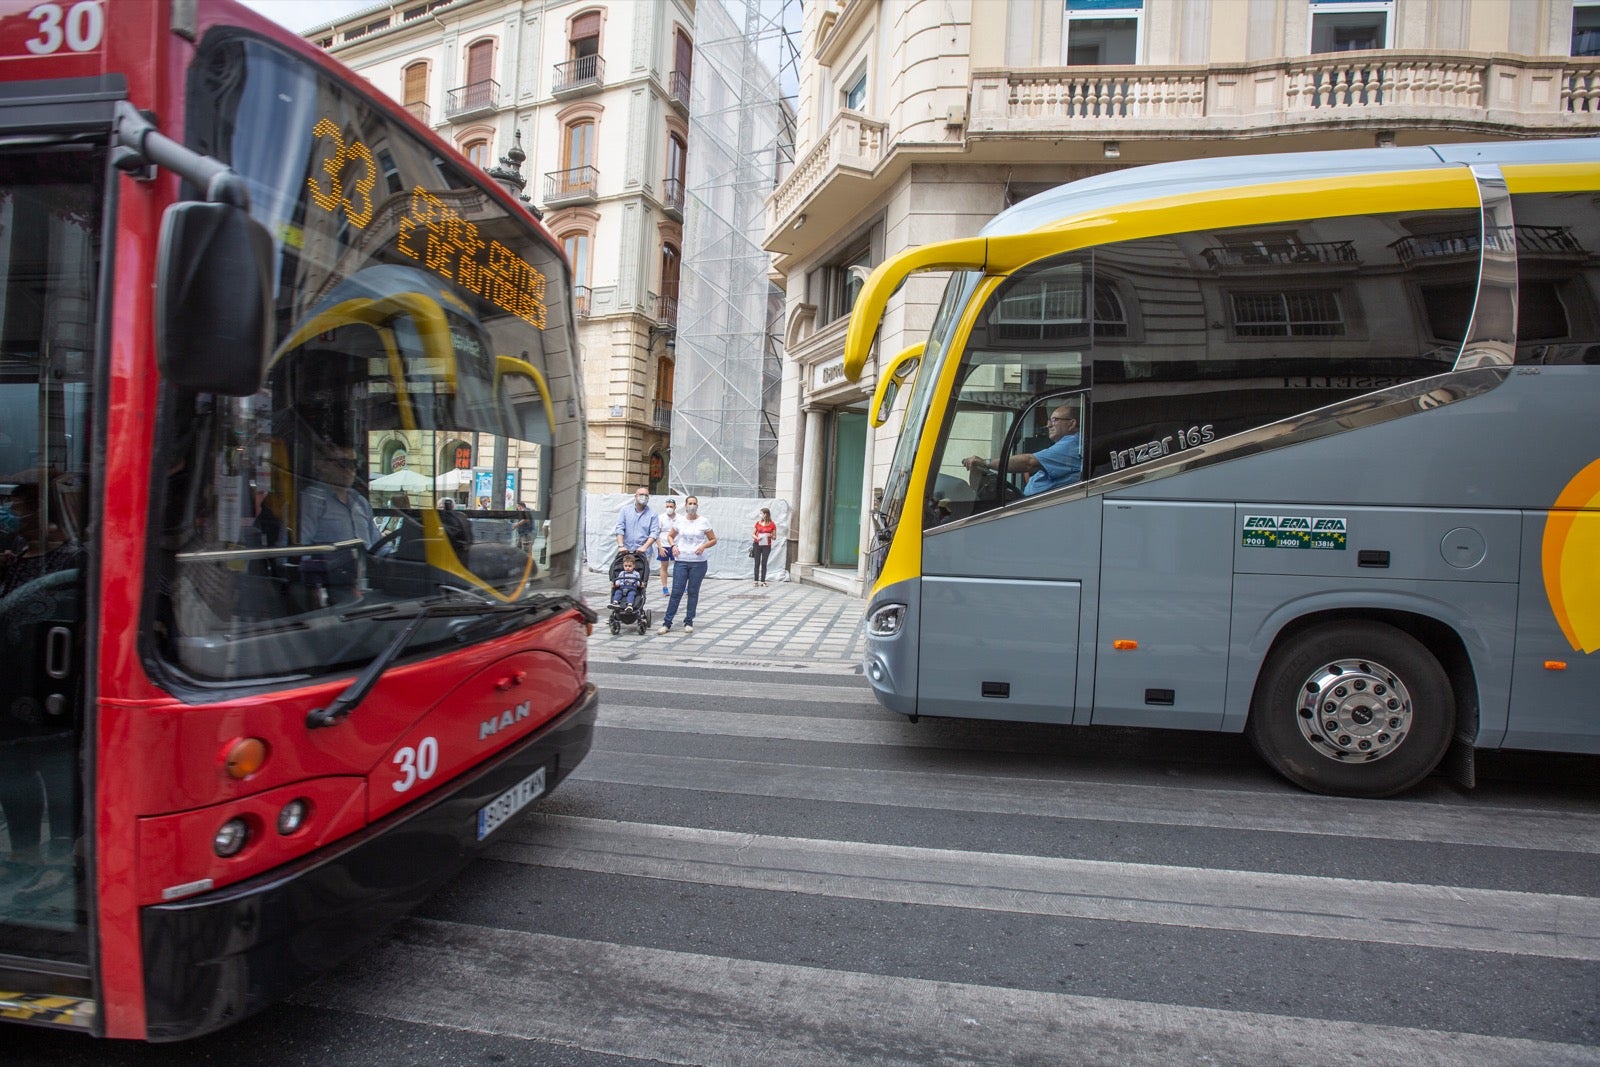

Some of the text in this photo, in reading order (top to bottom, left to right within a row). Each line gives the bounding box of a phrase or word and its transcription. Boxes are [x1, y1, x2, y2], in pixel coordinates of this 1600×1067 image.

[25, 1, 104, 55] 30
[307, 118, 376, 229] 33
[398, 216, 548, 331] E. DE AUTOBUSES
[489, 240, 546, 301] CENTRO
[393, 459, 406, 469] KING
[1178, 424, 1215, 450] i6s
[479, 701, 531, 740] MAN
[392, 736, 438, 793] 30
